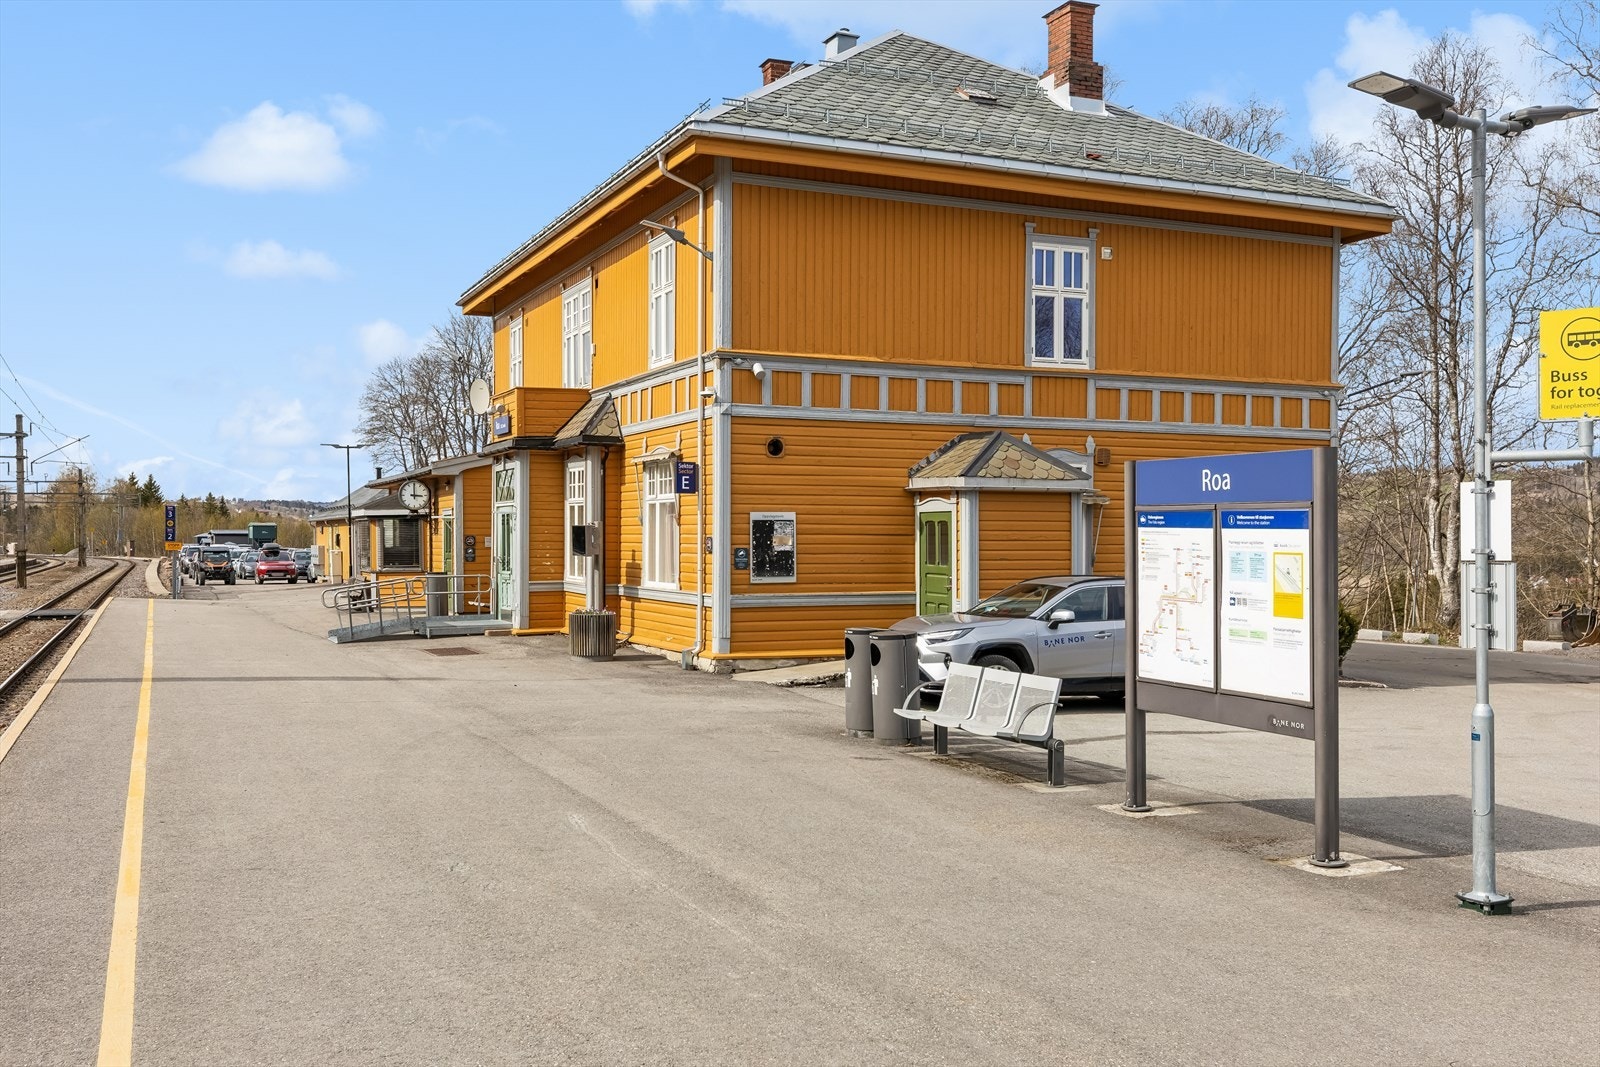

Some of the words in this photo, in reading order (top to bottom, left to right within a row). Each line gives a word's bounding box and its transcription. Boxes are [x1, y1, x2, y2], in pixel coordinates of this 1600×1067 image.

[1551, 370, 1588, 383] Buss
[1550, 386, 1574, 399] for
[682, 475, 690, 490] E
[1202, 469, 1231, 492] Roa
[167, 510, 173, 518] 3
[1044, 637, 1065, 648] BANE
[1068, 636, 1085, 644] NOR
[1272, 718, 1289, 727] BANE
[1290, 721, 1305, 730] NOR
